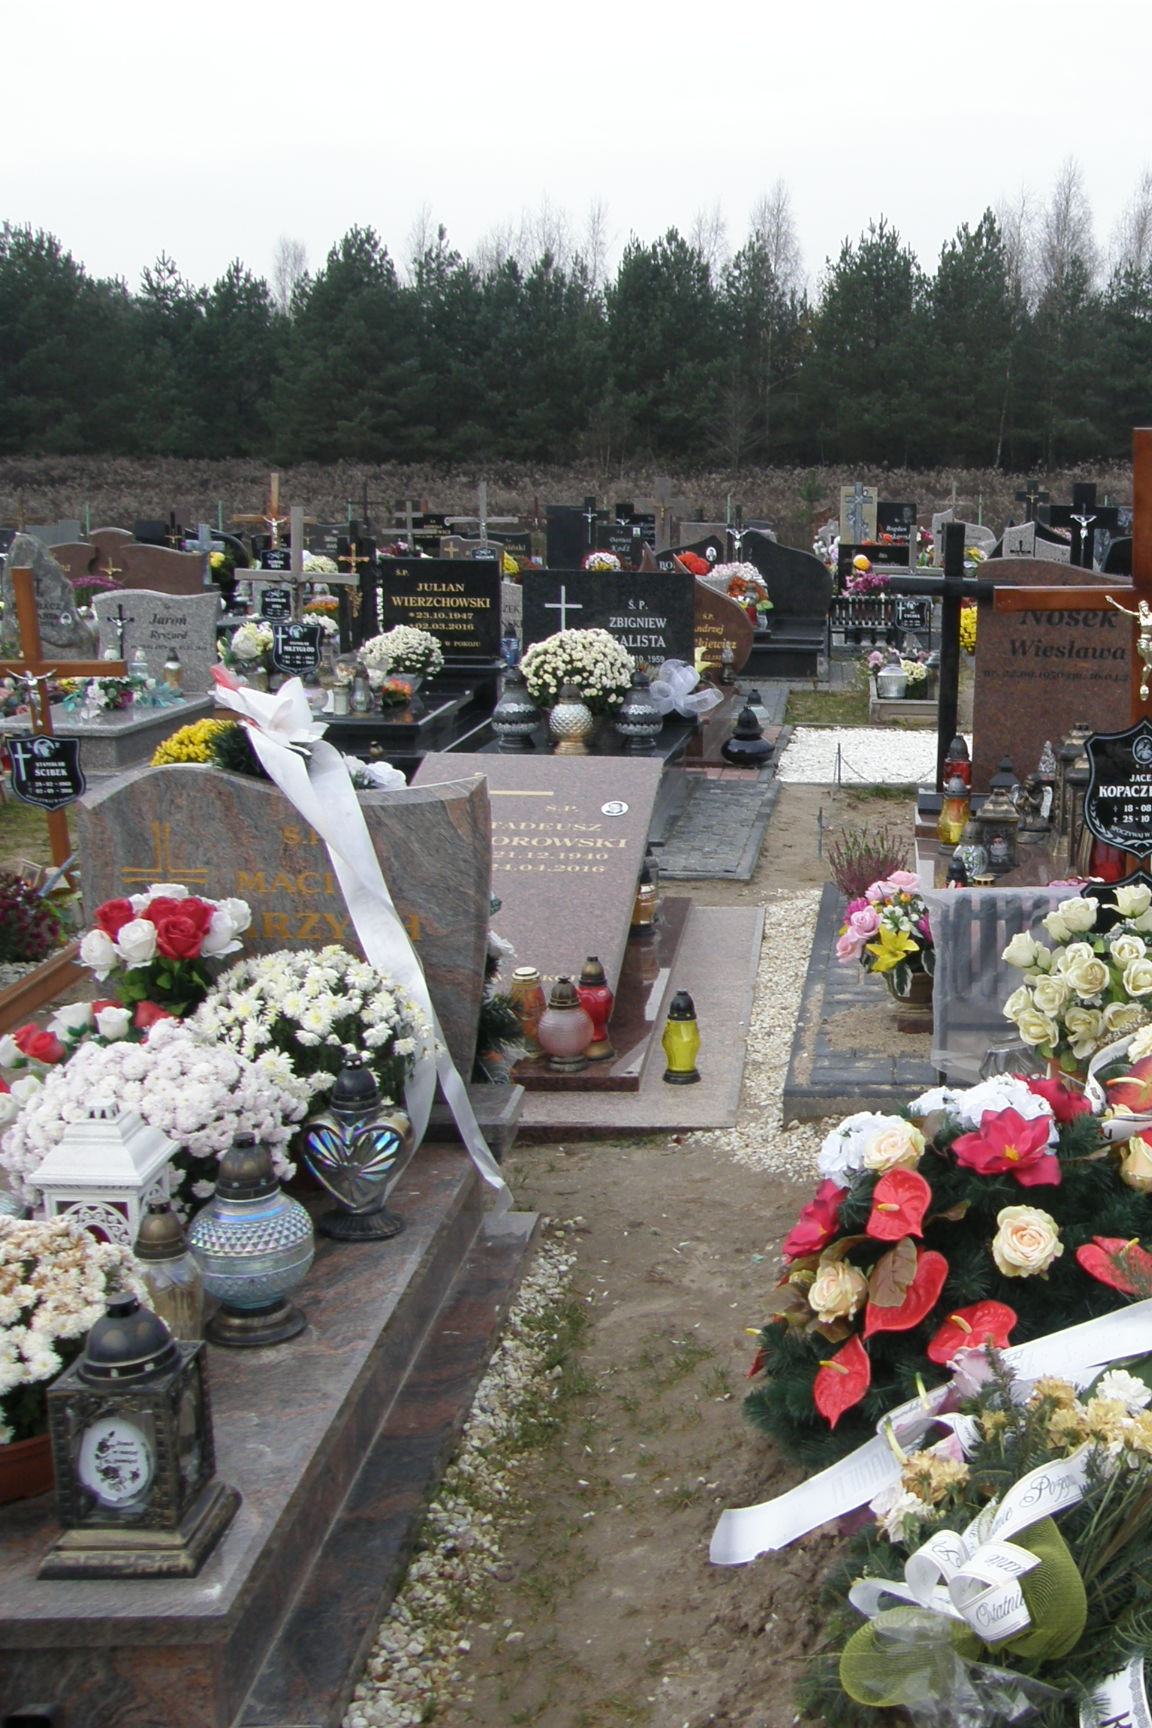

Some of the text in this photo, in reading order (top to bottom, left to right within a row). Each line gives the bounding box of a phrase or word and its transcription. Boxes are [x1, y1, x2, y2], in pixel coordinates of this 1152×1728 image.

[416, 583, 464, 592] JULIAN
[392, 596, 491, 608] WIERZCHOWSKI
[609, 616, 667, 629] ZBIGNIEW
[491, 821, 603, 832] TADEUSZ
